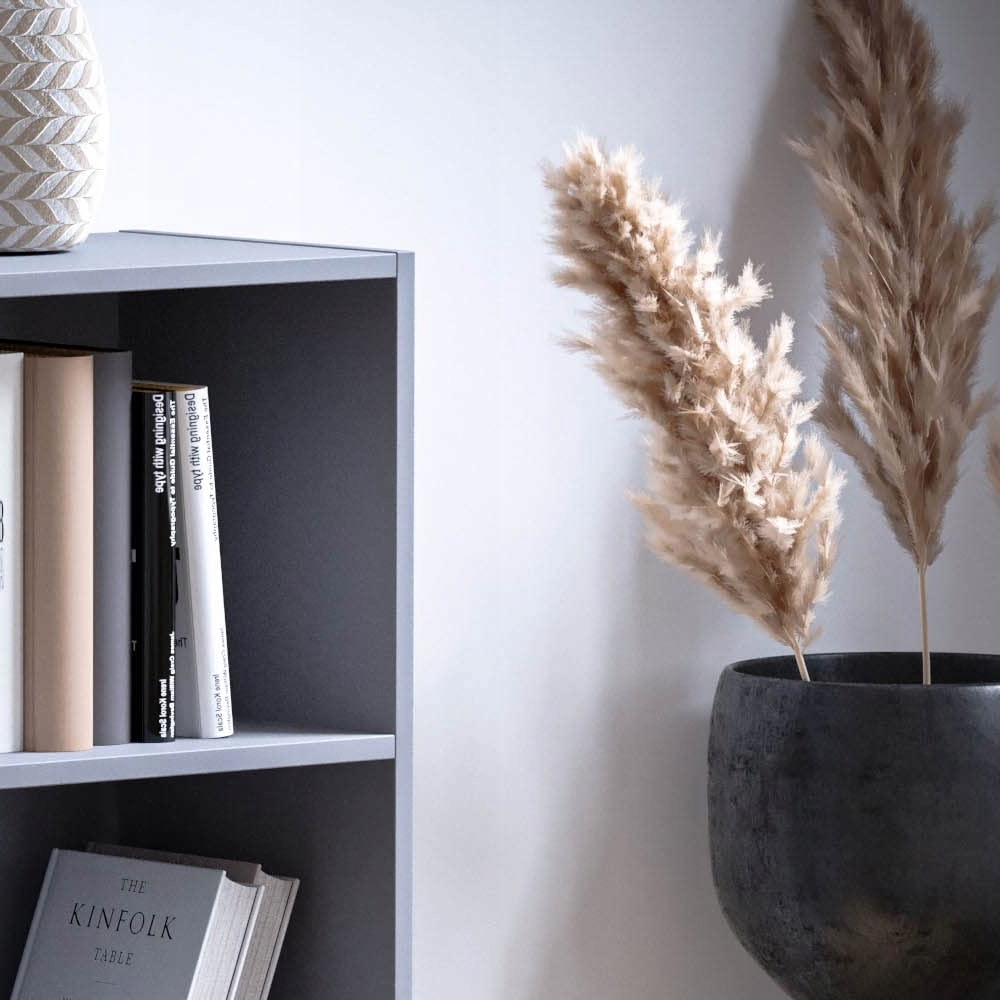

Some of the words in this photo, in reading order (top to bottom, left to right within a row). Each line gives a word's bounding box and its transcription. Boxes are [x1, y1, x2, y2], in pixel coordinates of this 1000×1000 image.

[120, 878, 147, 894] THE
[69, 902, 176, 940] KINFOLK
[93, 947, 134, 966] TABLE
